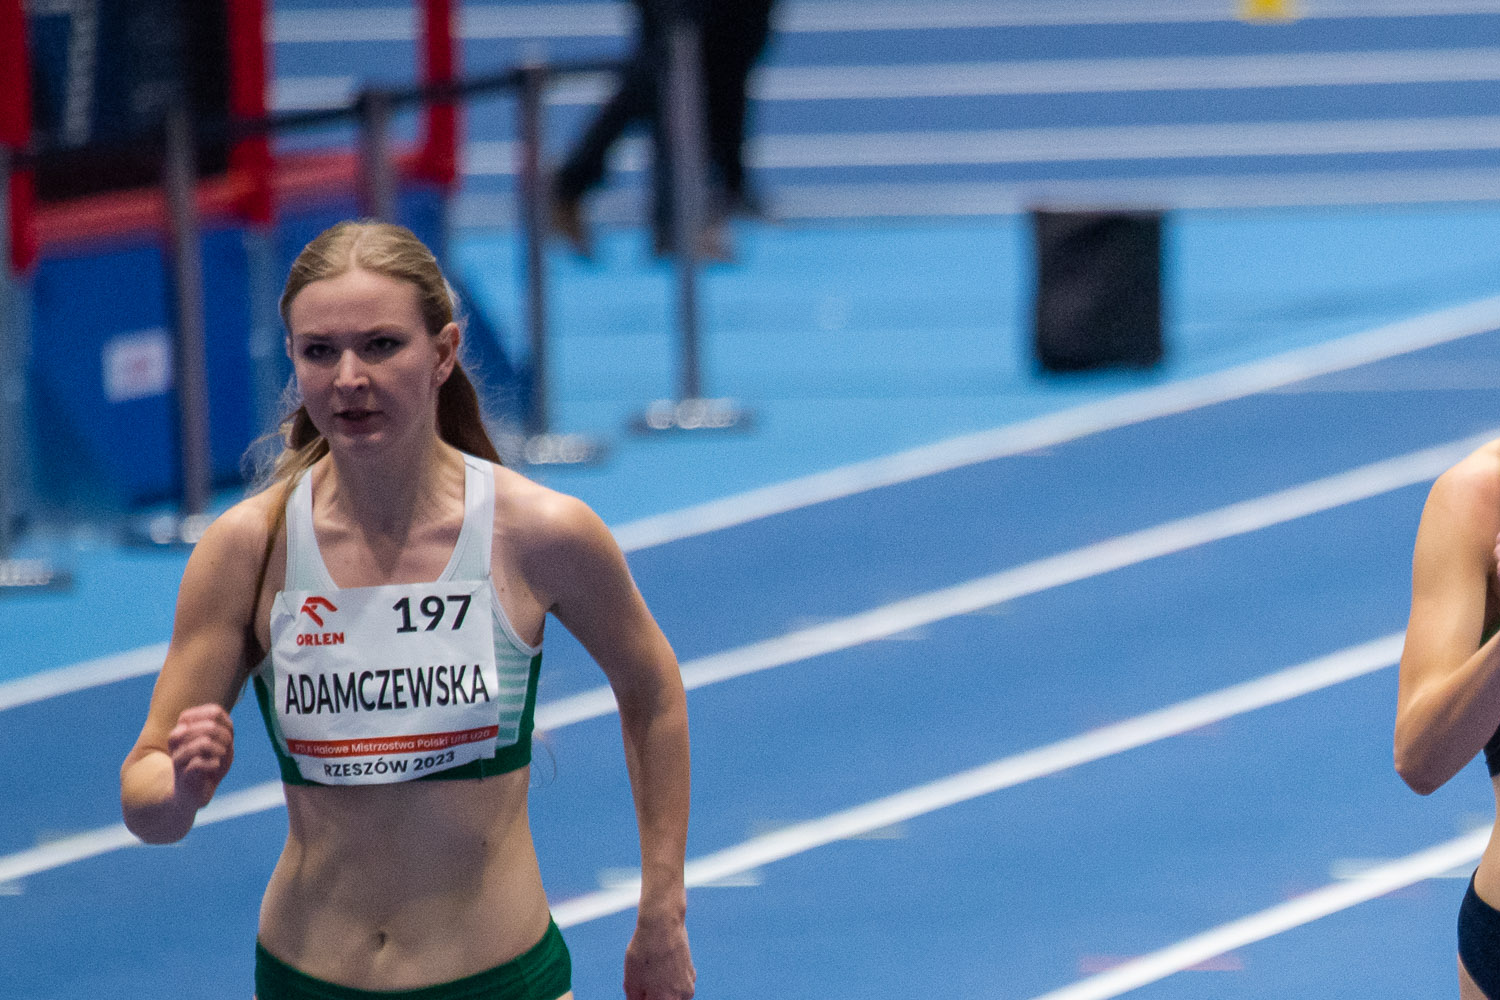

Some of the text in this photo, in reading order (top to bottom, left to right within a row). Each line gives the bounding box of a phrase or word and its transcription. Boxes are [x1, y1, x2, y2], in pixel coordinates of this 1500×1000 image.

[392, 594, 472, 633] 197
[296, 632, 345, 646] ORLEN
[285, 664, 490, 714] ADAMCZEWSKA
[313, 745, 349, 755] Halowe
[351, 740, 415, 753] Mistrzostwa
[417, 737, 448, 748] Polski
[323, 751, 455, 777] RZESZÓW 2023
